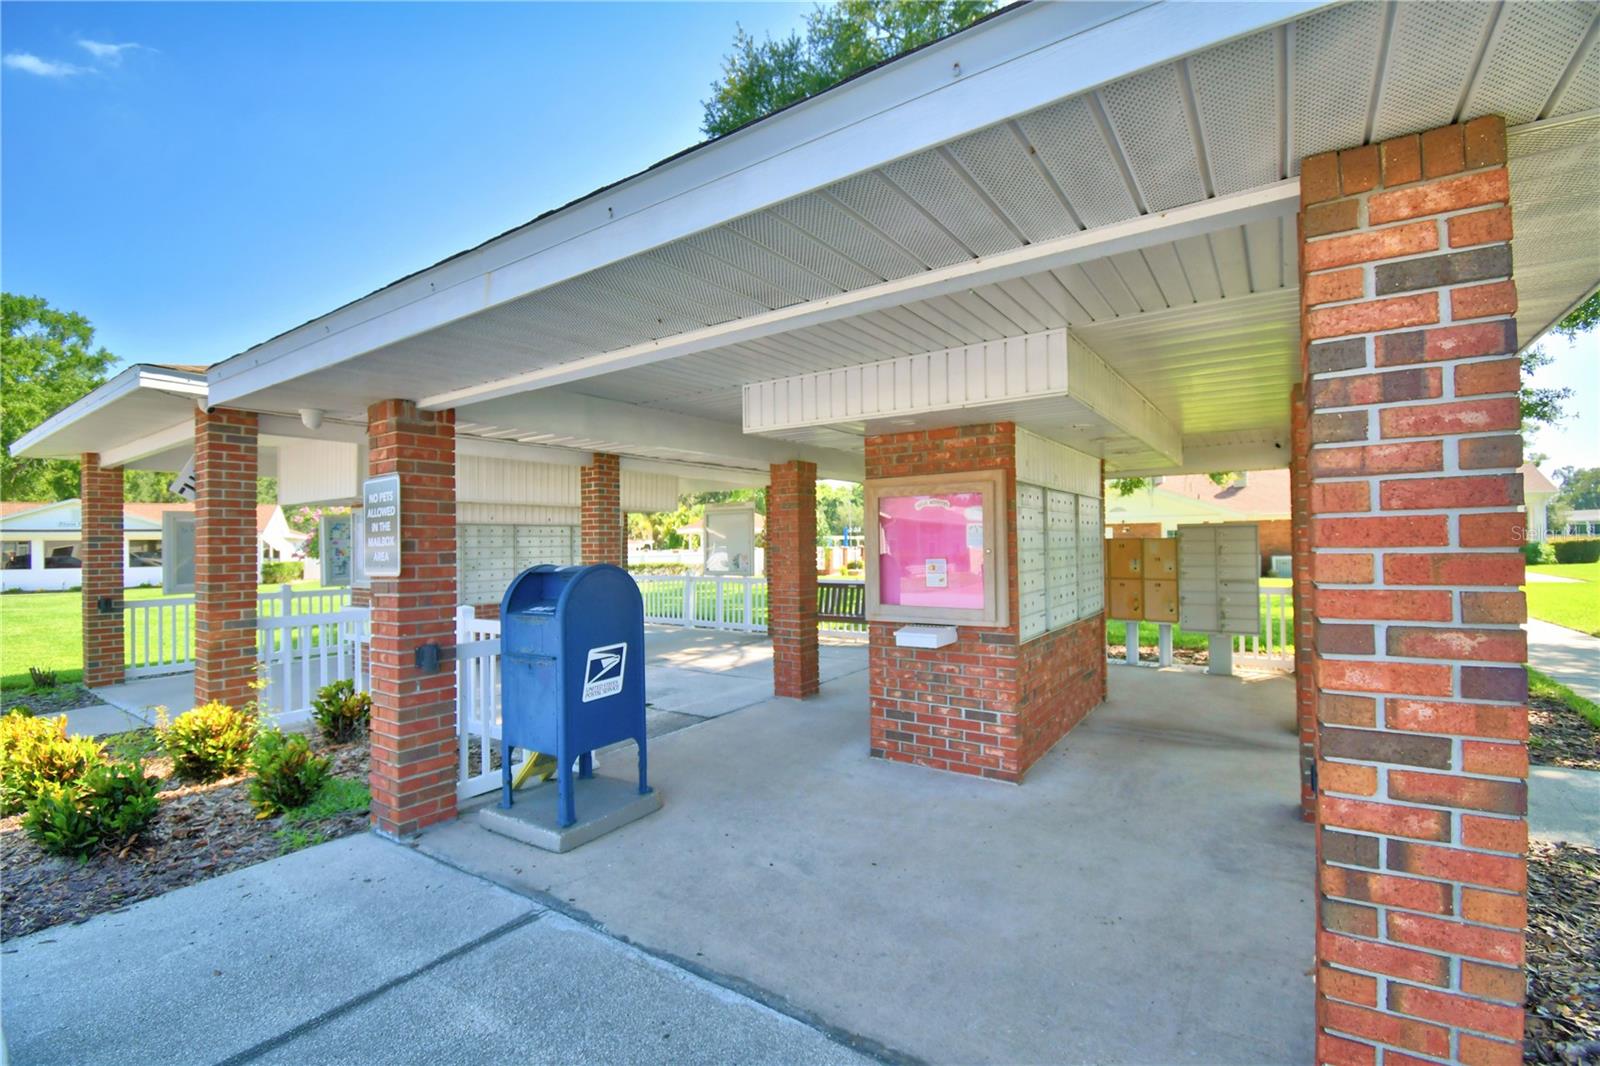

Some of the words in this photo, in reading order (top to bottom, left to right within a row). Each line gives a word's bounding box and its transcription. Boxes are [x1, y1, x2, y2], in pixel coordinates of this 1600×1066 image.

[368, 493, 378, 504] NO
[379, 492, 393, 503] PETS
[367, 506, 396, 518] ALLOWED
[371, 522, 378, 532] IN
[379, 521, 391, 532] THE
[367, 536, 395, 547] MAILBOX
[373, 552, 389, 562] AREA
